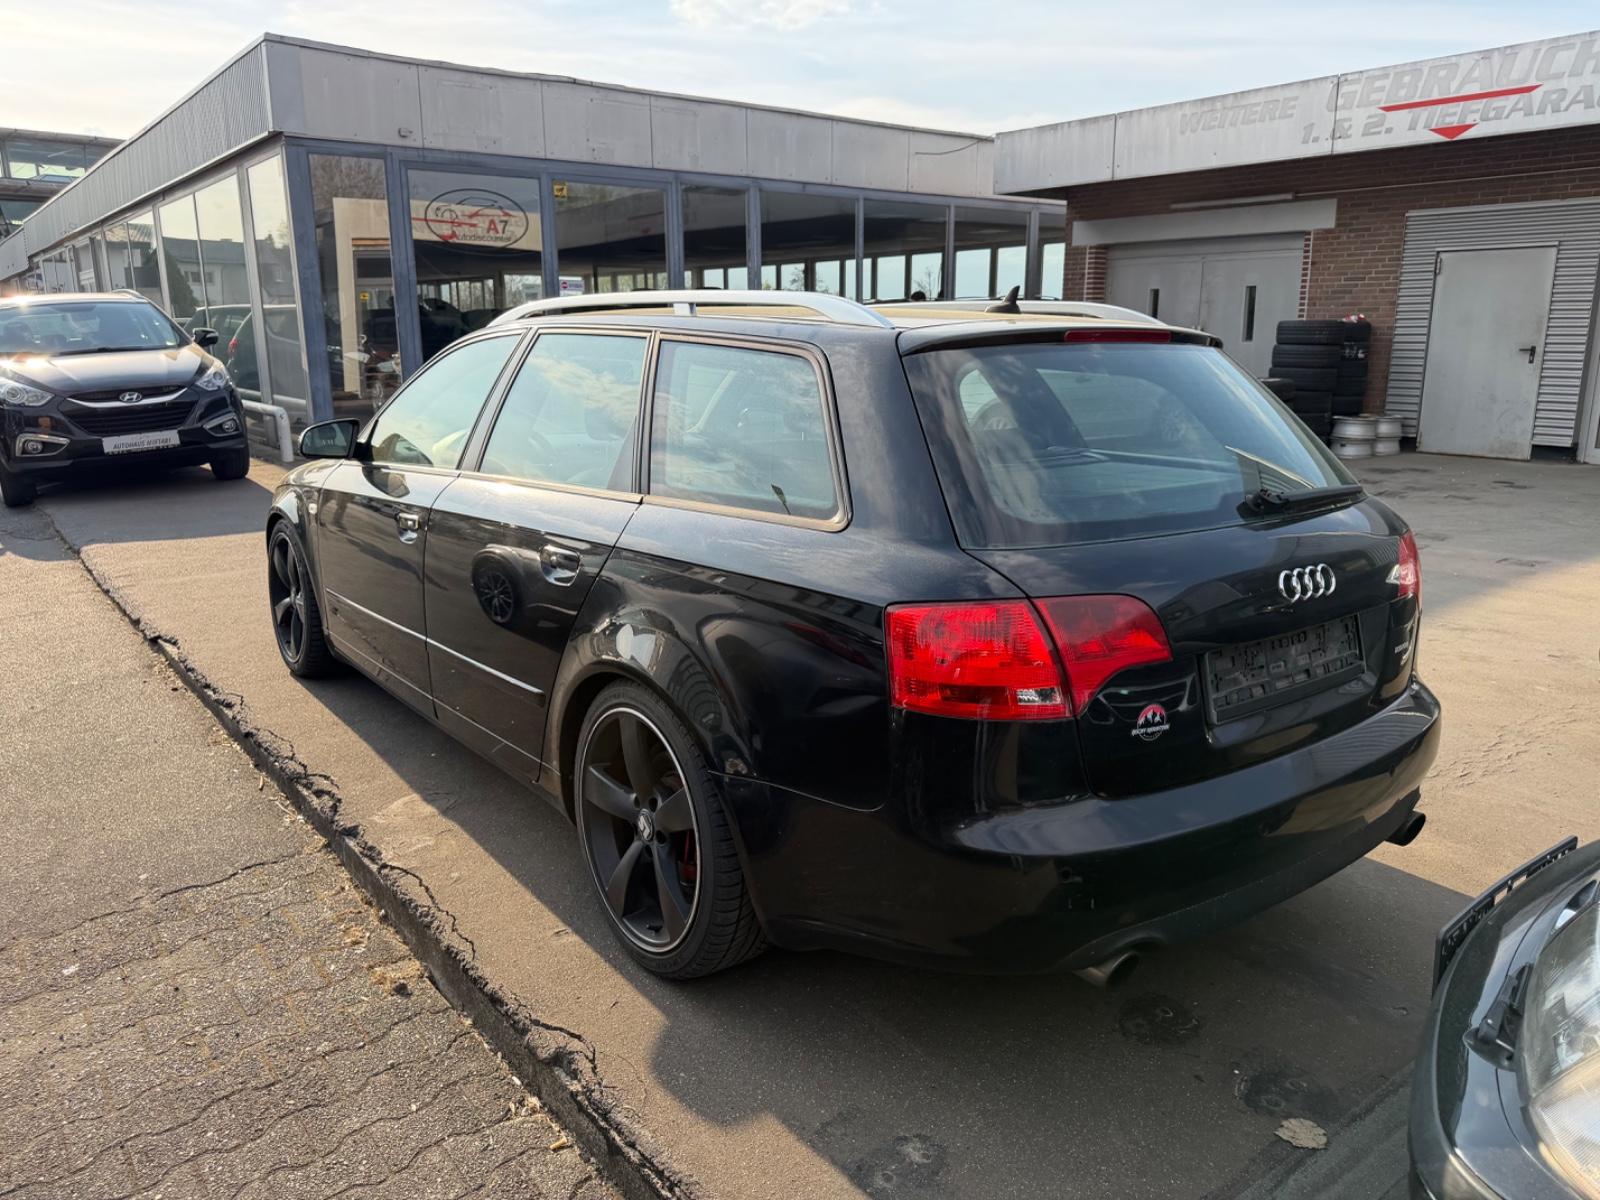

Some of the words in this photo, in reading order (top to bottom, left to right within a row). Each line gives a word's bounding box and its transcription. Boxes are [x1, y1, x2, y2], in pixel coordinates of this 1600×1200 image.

[1179, 96, 1299, 136] WEITERE
[1301, 121, 1320, 145] 1.
[1361, 112, 1394, 137] 2.
[1407, 84, 1600, 131] TIEFGARA
[486, 217, 509, 235] A7
[113, 441, 145, 449] AUTOHAUS
